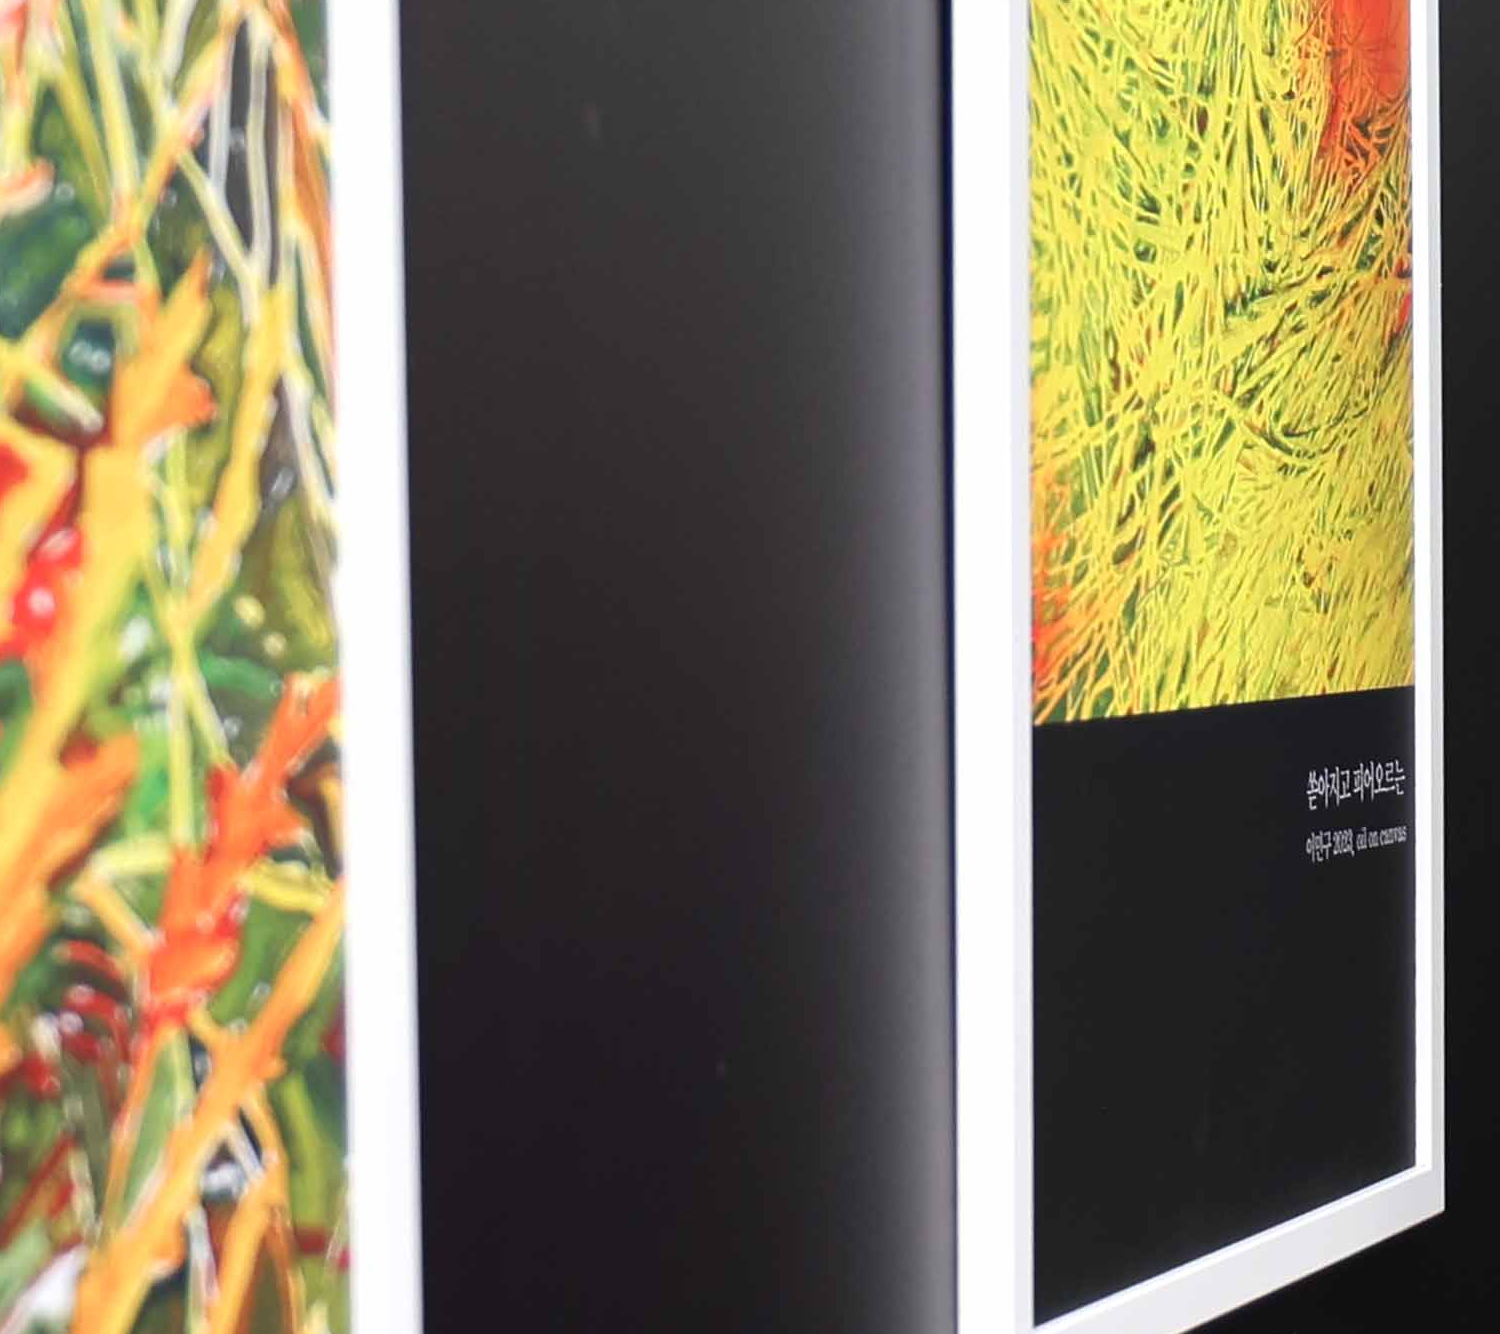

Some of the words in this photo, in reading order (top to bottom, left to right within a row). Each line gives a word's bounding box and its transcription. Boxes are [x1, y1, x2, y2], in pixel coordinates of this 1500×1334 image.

[1306, 766, 1351, 810] 쏟아지고
[1353, 759, 1406, 802] 피어오르는
[1356, 827, 1368, 851] oil
[1368, 830, 1379, 848] on
[1379, 825, 1407, 846] canvas
